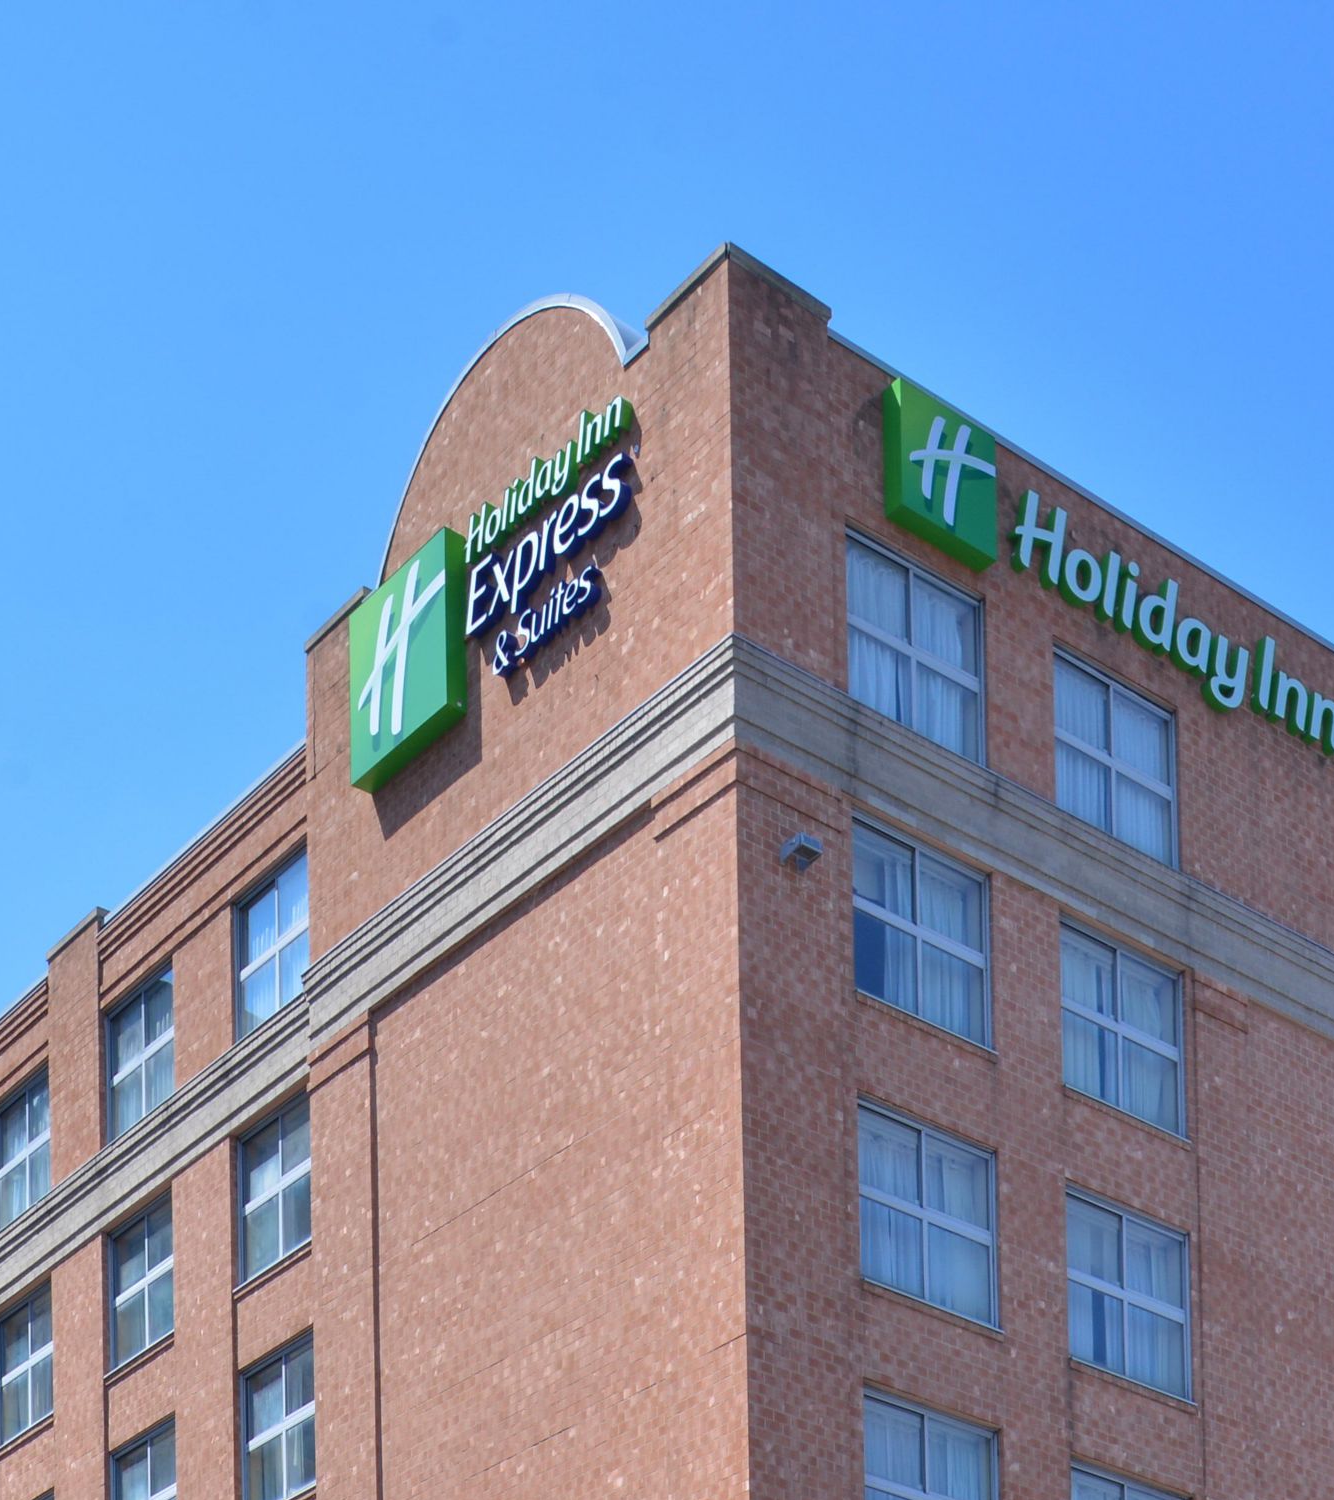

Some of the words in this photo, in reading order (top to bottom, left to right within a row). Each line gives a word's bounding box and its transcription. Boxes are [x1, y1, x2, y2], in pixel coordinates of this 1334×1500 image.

[464, 439, 576, 564] Holiday
[576, 396, 623, 464] Inn
[466, 453, 624, 636] Express
[492, 630, 510, 676] &
[514, 565, 594, 657] Suites
[1013, 488, 1250, 709] Holiday
